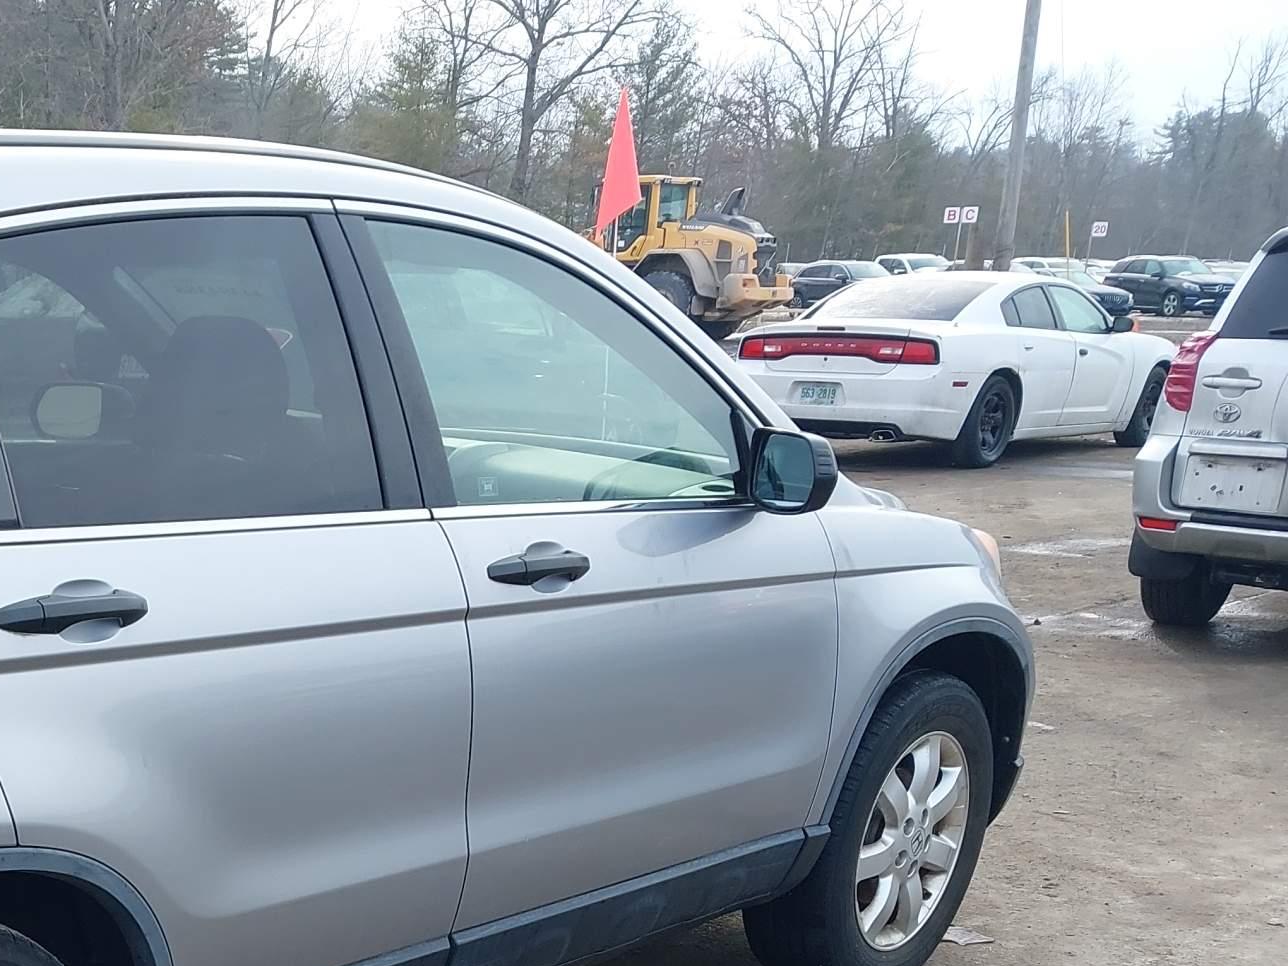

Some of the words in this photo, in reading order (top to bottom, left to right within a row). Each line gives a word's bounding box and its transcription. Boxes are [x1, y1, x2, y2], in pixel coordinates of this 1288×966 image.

[947, 209, 957, 221] B
[965, 209, 976, 221] C
[1094, 224, 1107, 234] 20
[800, 386, 815, 399] 563
